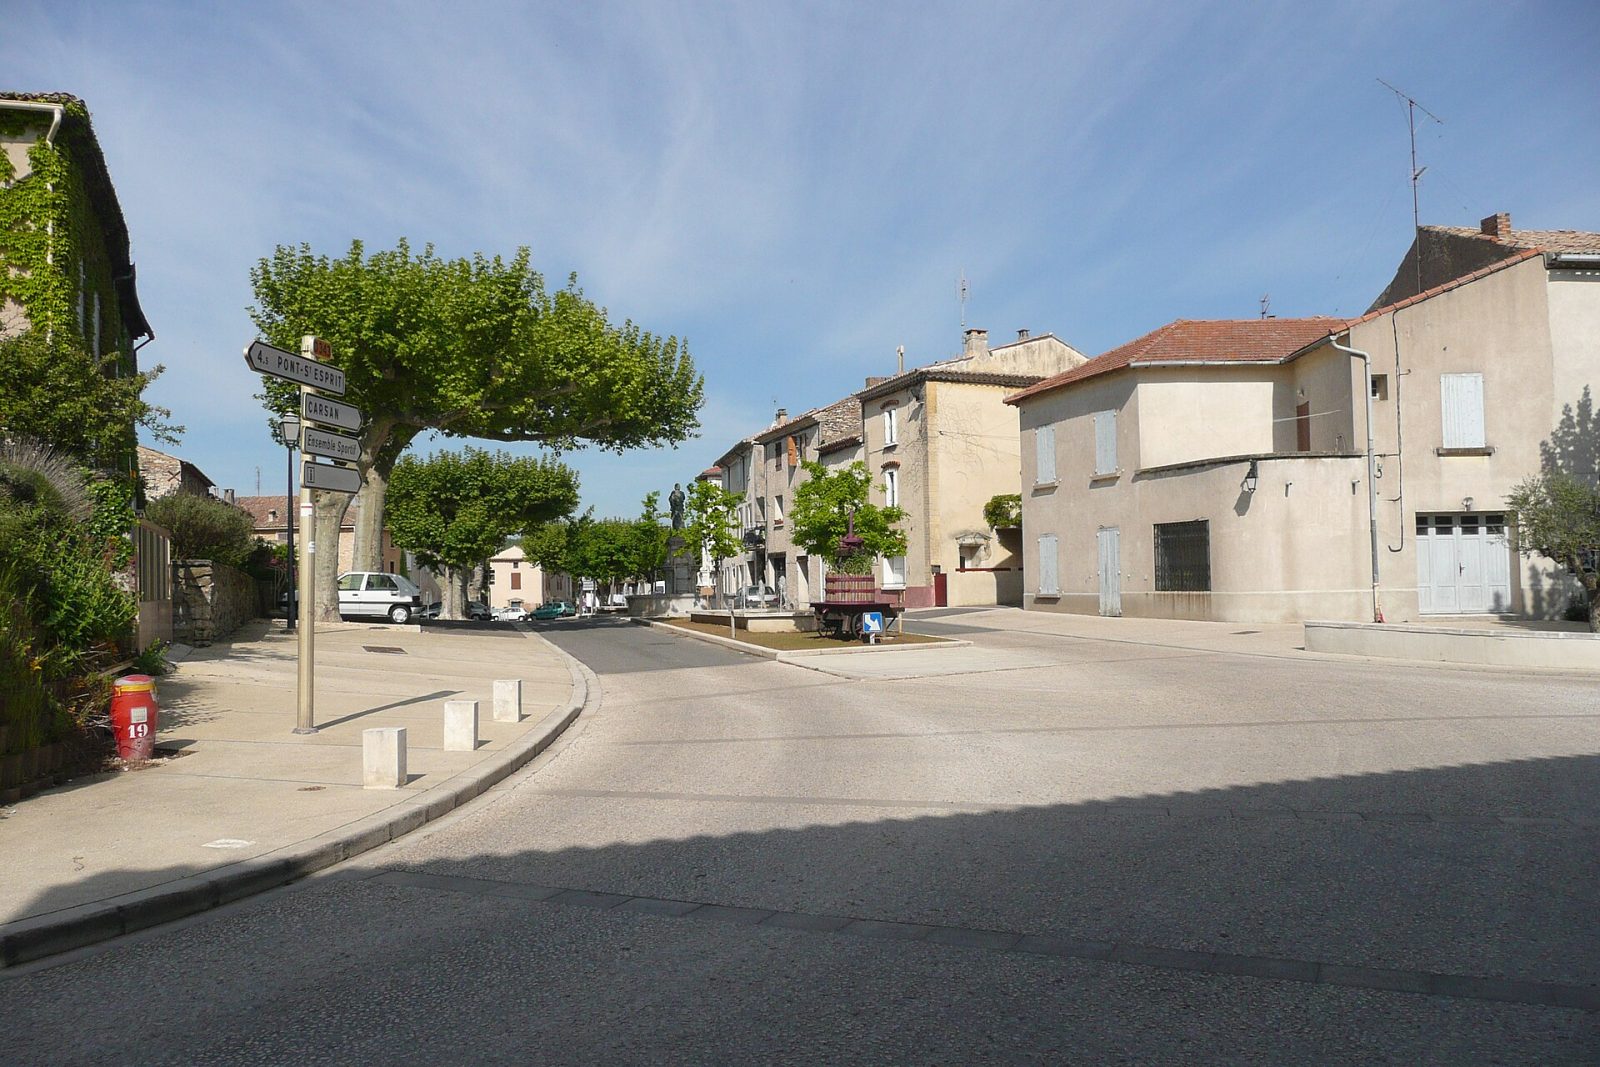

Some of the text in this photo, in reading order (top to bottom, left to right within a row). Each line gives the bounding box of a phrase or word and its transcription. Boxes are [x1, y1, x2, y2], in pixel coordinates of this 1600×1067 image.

[314, 368, 342, 388] ESPRIT
[308, 401, 339, 420] CARSAN
[307, 434, 357, 455] Ensemble Sportif
[128, 723, 148, 738] 19
